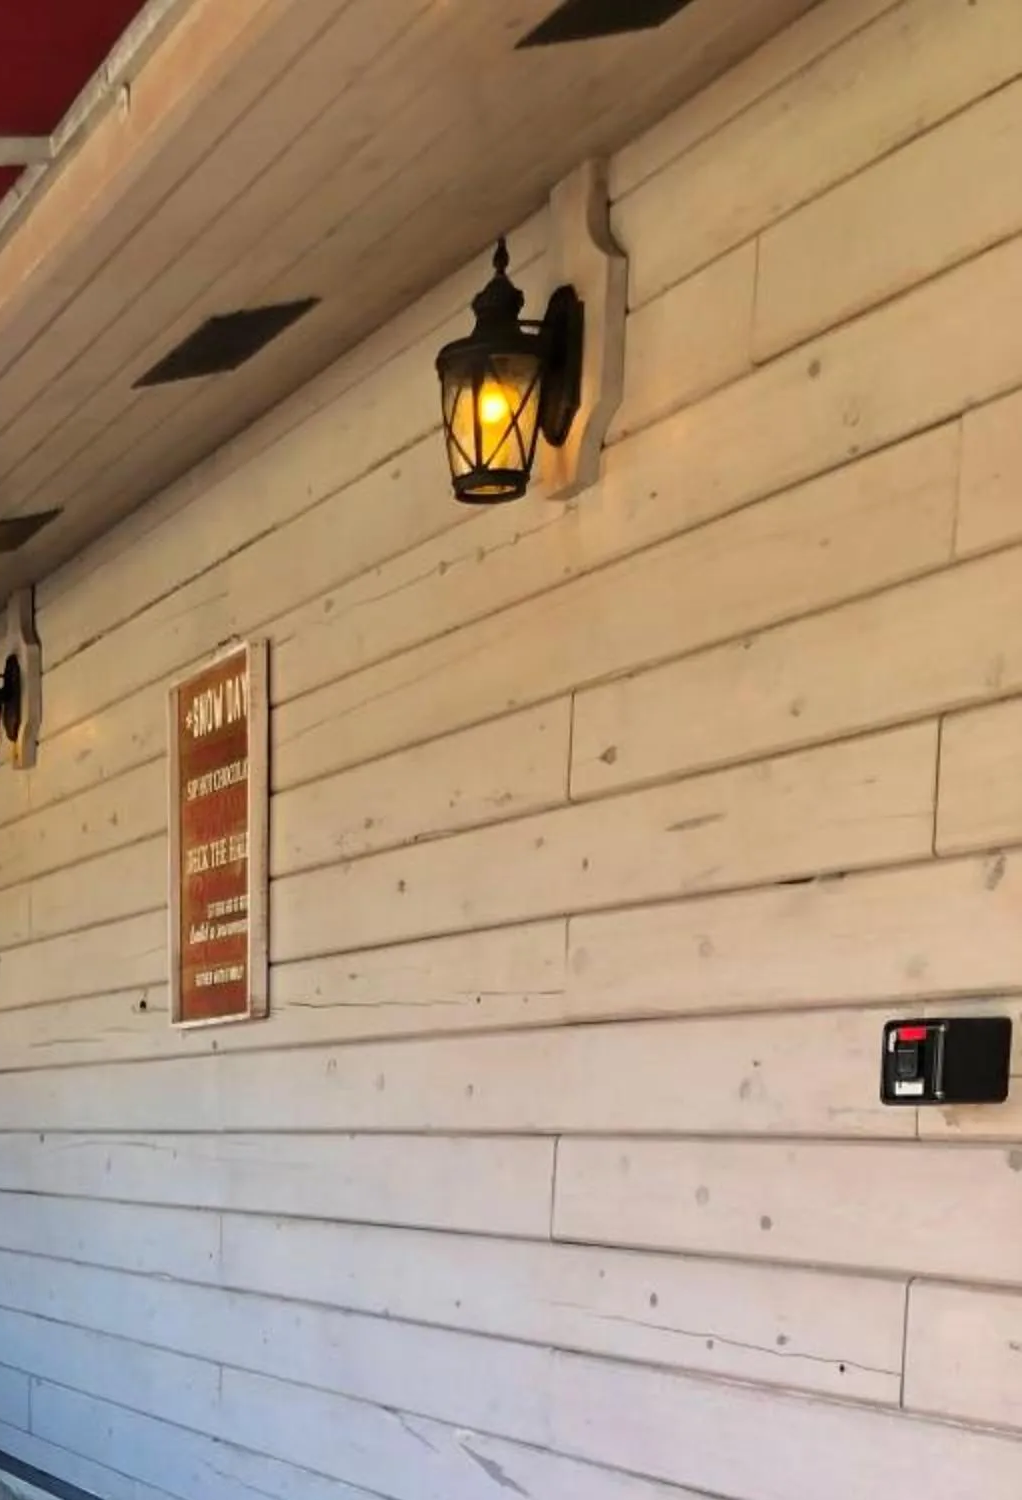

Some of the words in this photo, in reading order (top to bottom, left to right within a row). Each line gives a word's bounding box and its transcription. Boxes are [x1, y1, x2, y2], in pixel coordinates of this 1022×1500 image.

[193, 683, 223, 738] SNOW
[226, 673, 248, 723] DAY
[210, 838, 226, 867] THE
